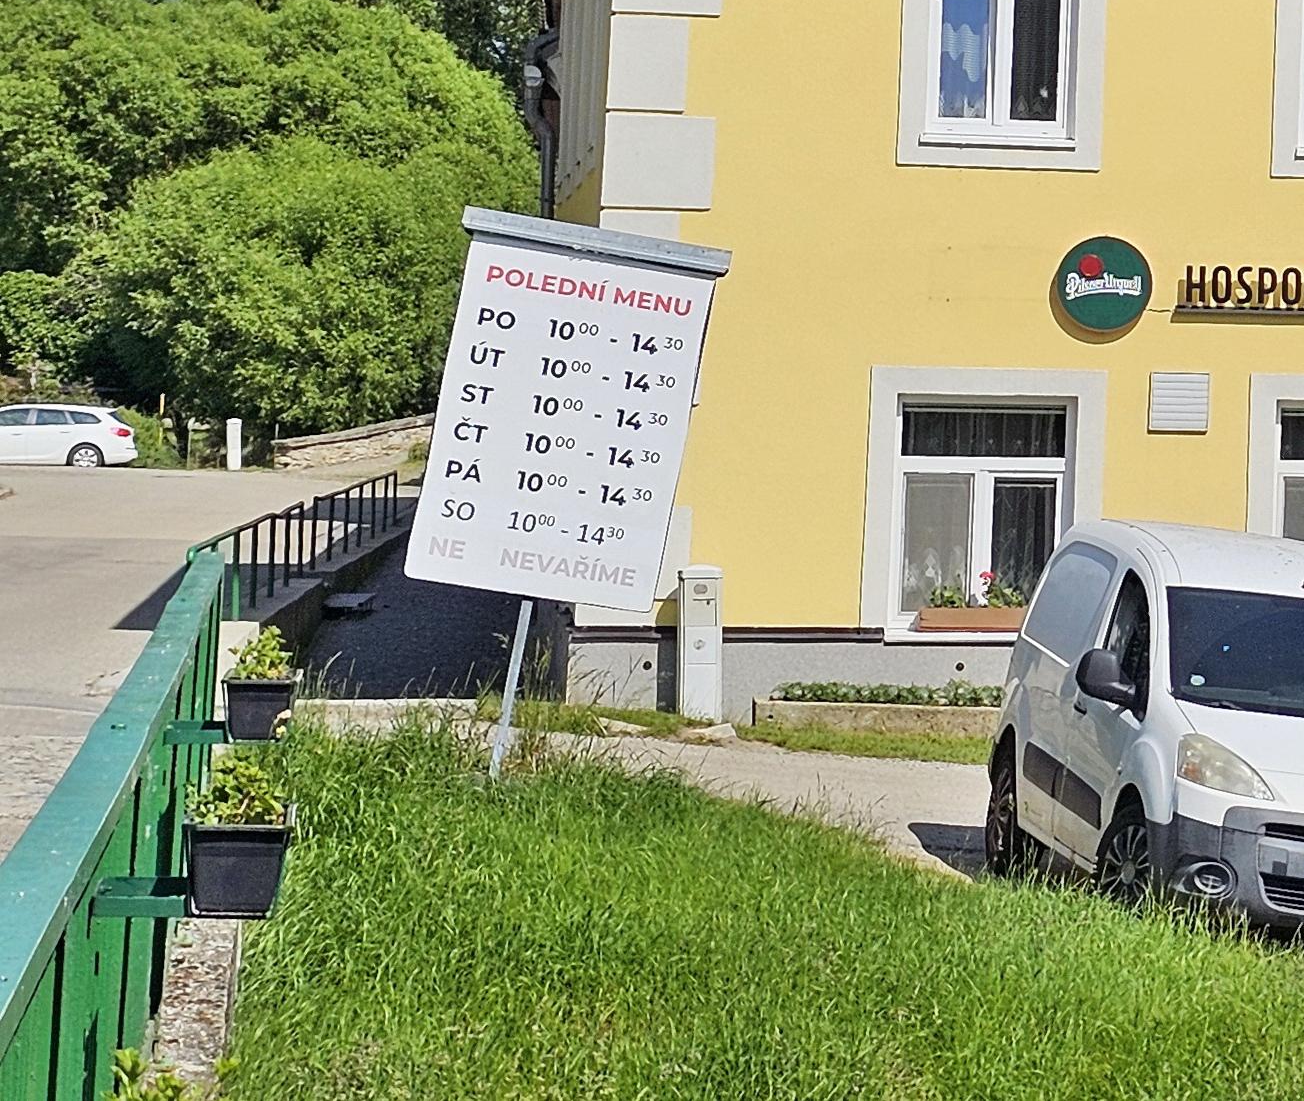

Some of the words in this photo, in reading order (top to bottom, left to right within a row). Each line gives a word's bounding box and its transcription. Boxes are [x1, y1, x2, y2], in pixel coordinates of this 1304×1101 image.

[485, 264, 609, 303] POLEDNÍ
[612, 286, 692, 317] MENU
[476, 306, 517, 330] PO
[469, 340, 507, 368] ÚT
[459, 383, 495, 405] ST
[453, 415, 490, 444] ČT
[444, 458, 482, 484] PÁ
[440, 498, 476, 522] SO
[428, 536, 466, 560] NE
[499, 548, 637, 588] NEVAŘÍME
